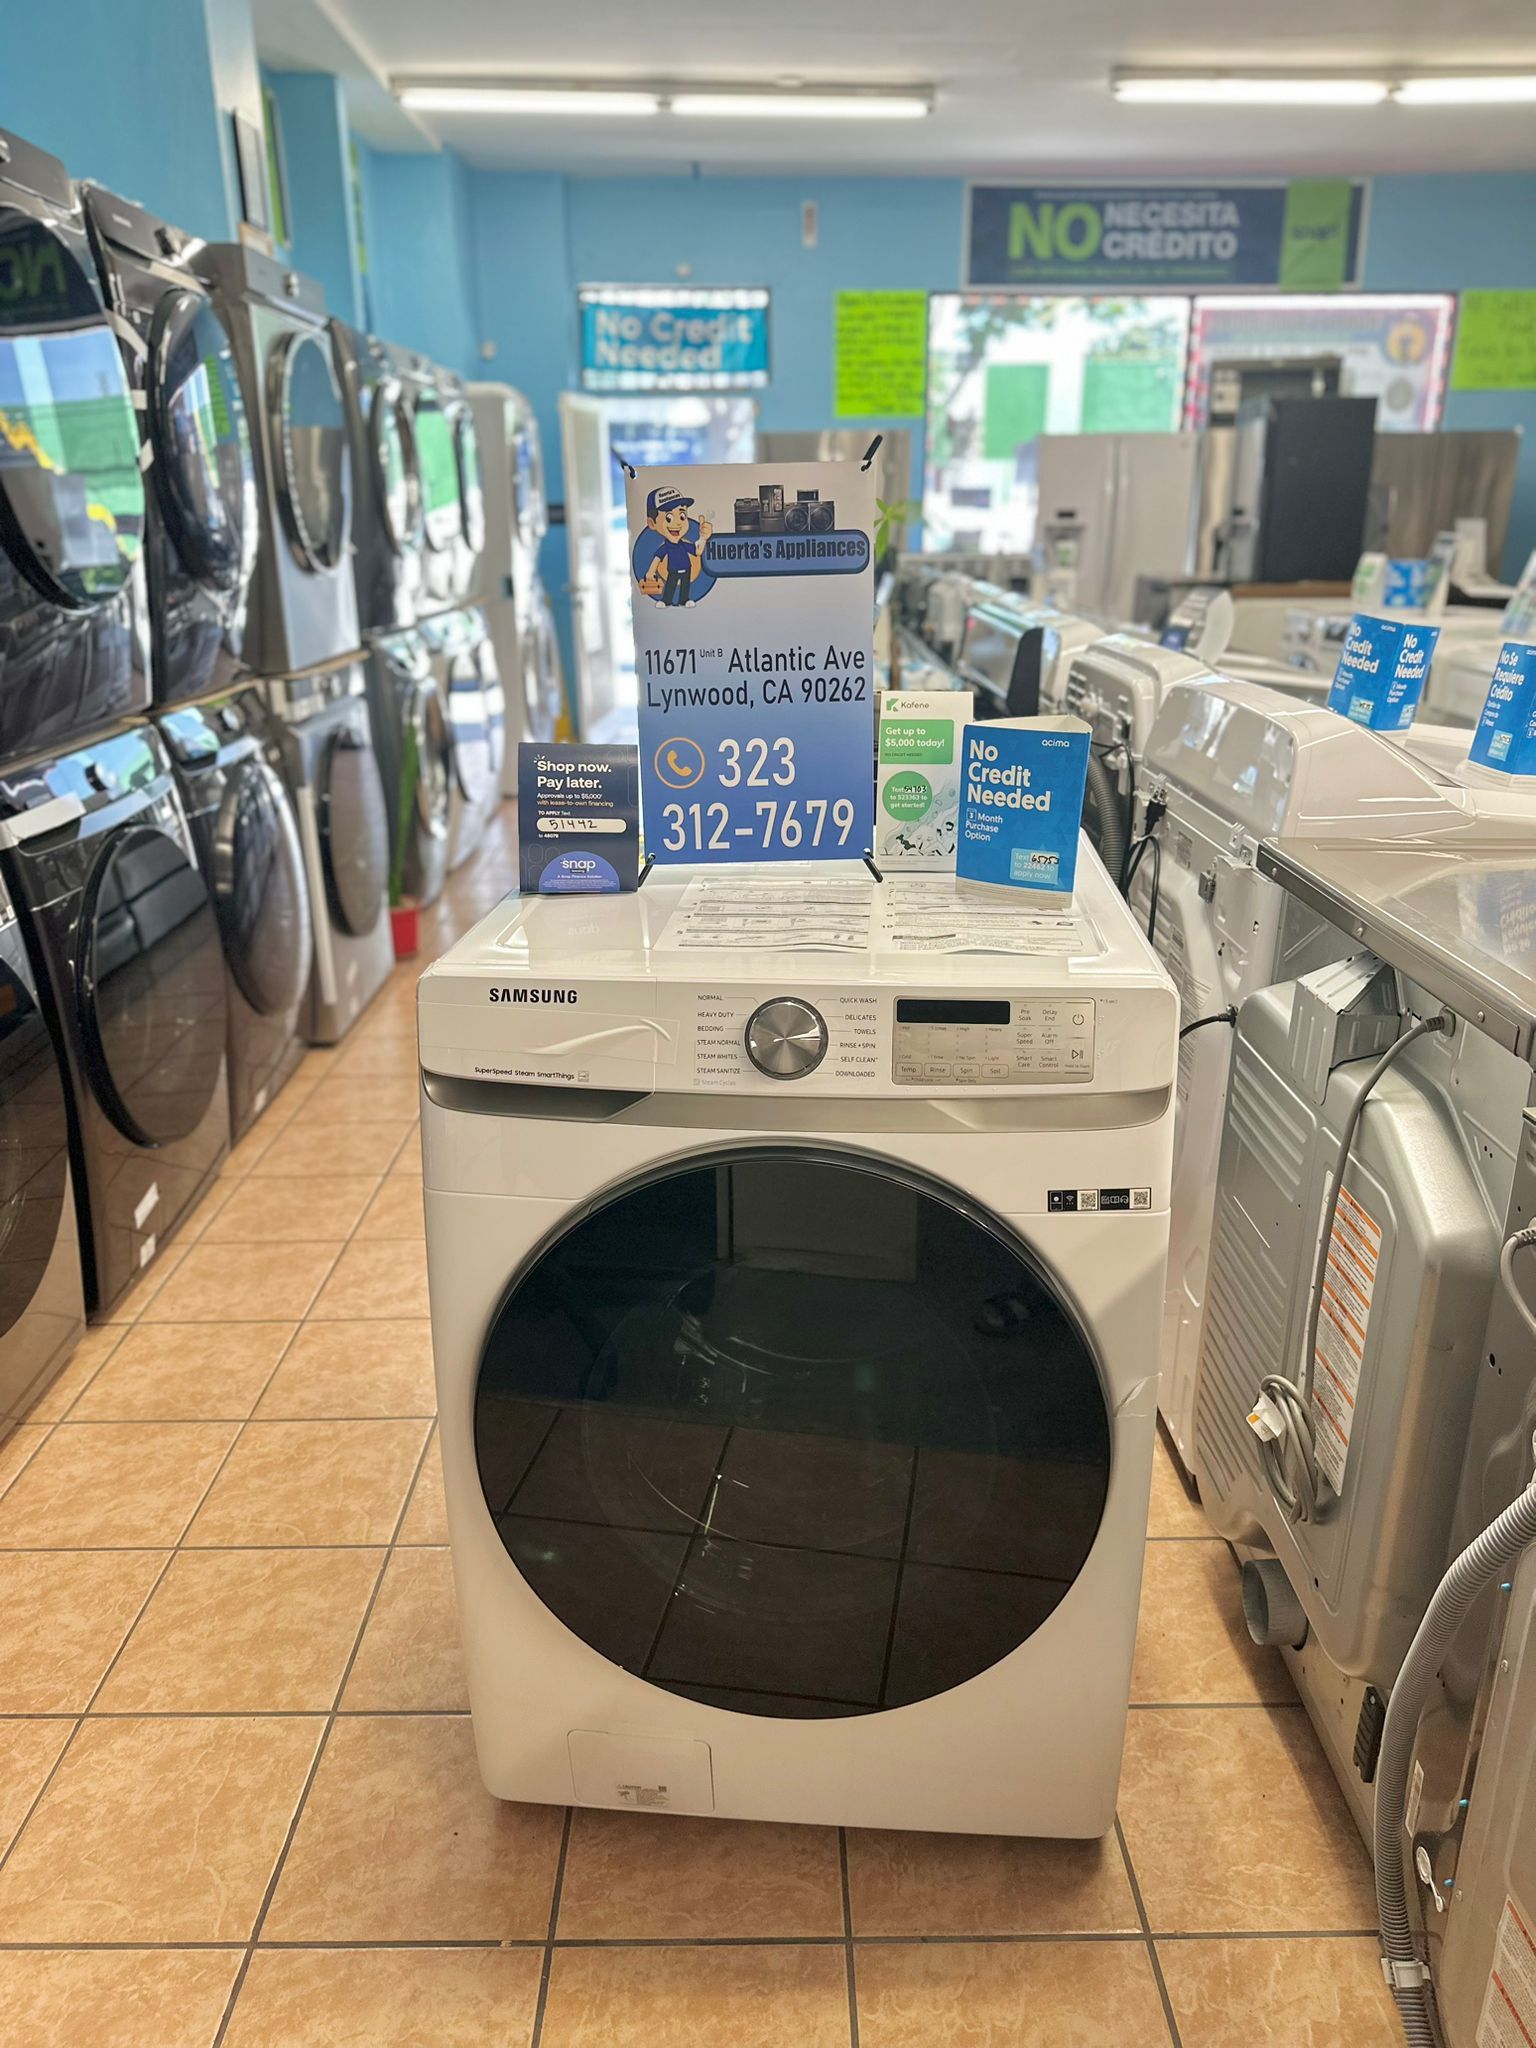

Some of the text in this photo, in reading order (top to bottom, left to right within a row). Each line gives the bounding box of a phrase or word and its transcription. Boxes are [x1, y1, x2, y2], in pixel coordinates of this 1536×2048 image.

[1008, 201, 1239, 261] NO NECESITA
[1102, 228, 1238, 259] CRÉDITO
[596, 310, 752, 345] No Credit
[596, 340, 722, 371] Needed
[706, 539, 866, 560] Huerta's Appliances
[1346, 636, 1372, 656] Credit
[1404, 634, 1418, 648] No
[645, 645, 865, 674] 11671 Unit B Atlantic Ave
[1342, 651, 1380, 674] Needed
[1400, 649, 1424, 664] Credit
[1500, 650, 1510, 665] No
[1509, 652, 1518, 666] Se
[1394, 664, 1426, 678] Needed
[1494, 667, 1524, 686] Requiere
[648, 676, 866, 713] Lynwood, CA 90262
[1490, 684, 1514, 701] Crédito
[900, 701, 930, 709] Kafene
[886, 727, 901, 735] Get
[902, 729, 914, 737] up
[885, 738, 945, 748] $5,000 today!
[969, 738, 998, 762] No
[1042, 738, 1070, 748] acima
[537, 760, 612, 774] Shop now.
[718, 737, 796, 788] 323
[537, 776, 602, 790] Pay later.
[968, 762, 1031, 788] Credit
[967, 784, 1050, 812] Needed
[549, 820, 598, 830] 51442
[662, 798, 854, 851] 312-7679
[966, 820, 999, 832] Purchase
[977, 812, 1003, 824] Month
[964, 831, 990, 842] Option
[562, 860, 596, 872] snap
[1014, 870, 1033, 878] apply
[490, 988, 578, 1004] SAMSUNG
[474, 1067, 512, 1075] SuperSpeed
[537, 1072, 575, 1080] SmartThings
